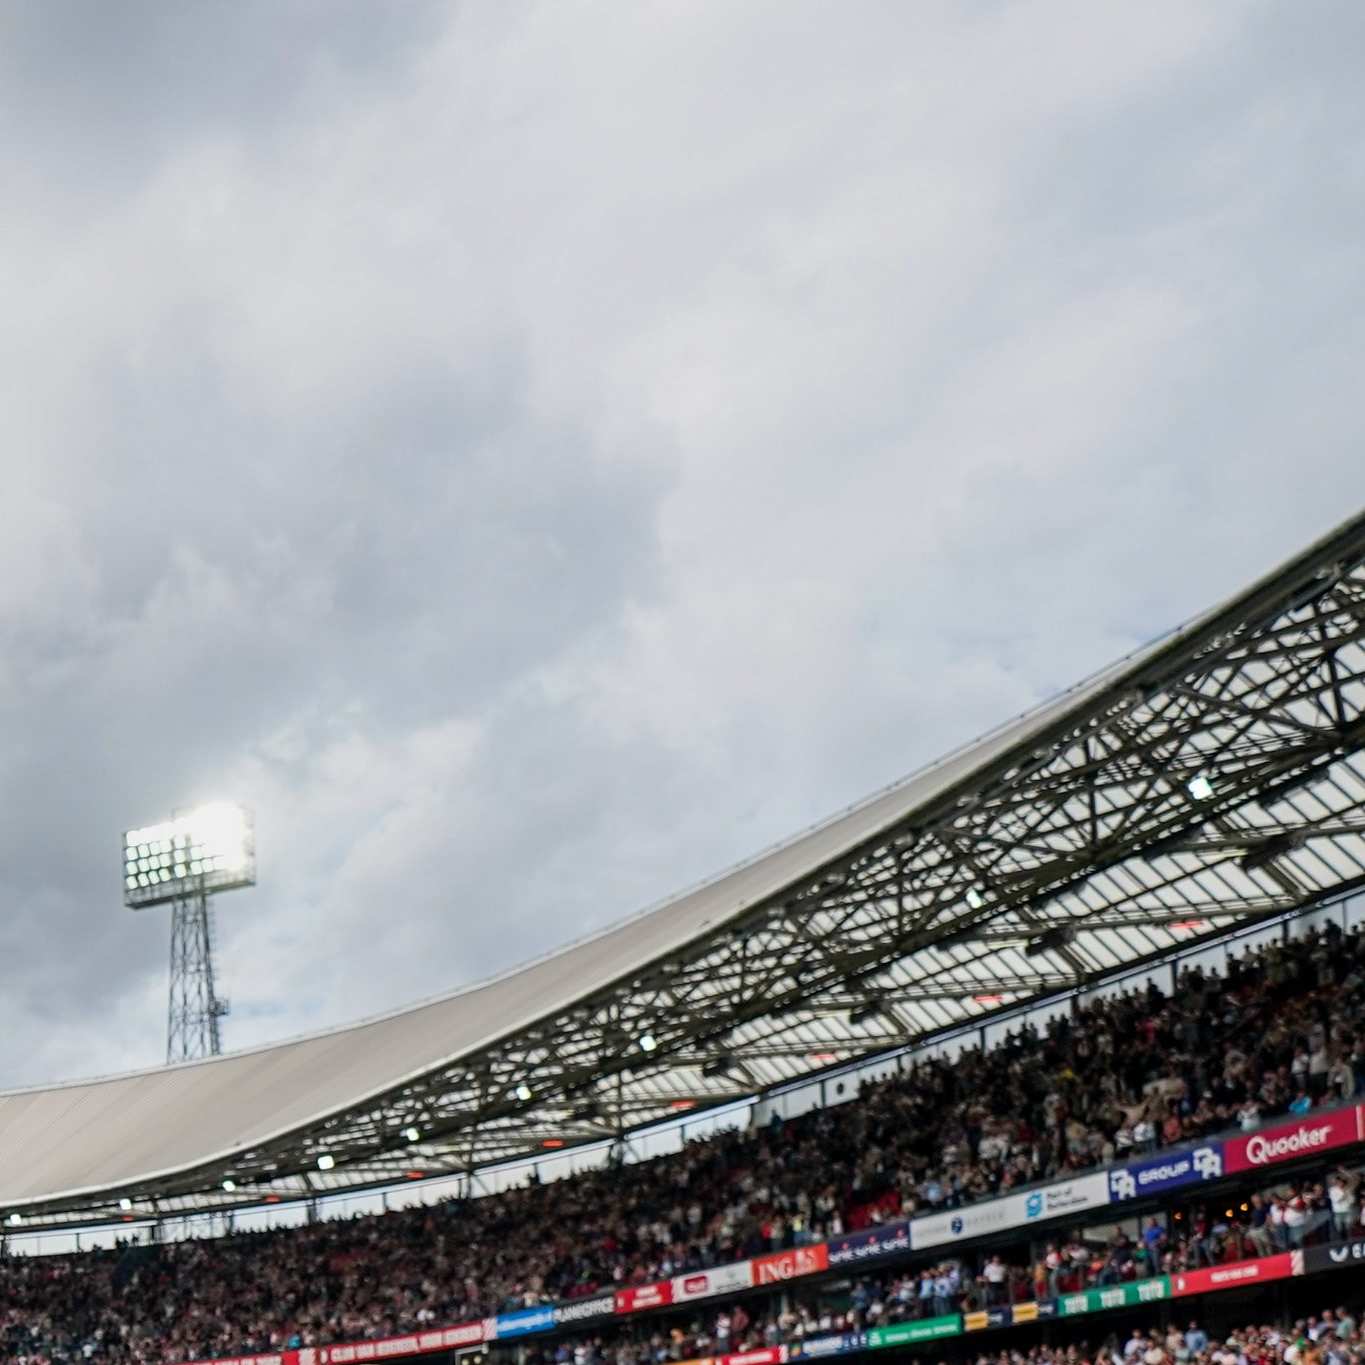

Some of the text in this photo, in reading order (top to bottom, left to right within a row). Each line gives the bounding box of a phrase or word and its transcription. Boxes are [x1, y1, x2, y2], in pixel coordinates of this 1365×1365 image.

[1246, 1125, 1333, 1164] Quooker
[1138, 1160, 1190, 1185] GROUP
[758, 1260, 793, 1284] ING
